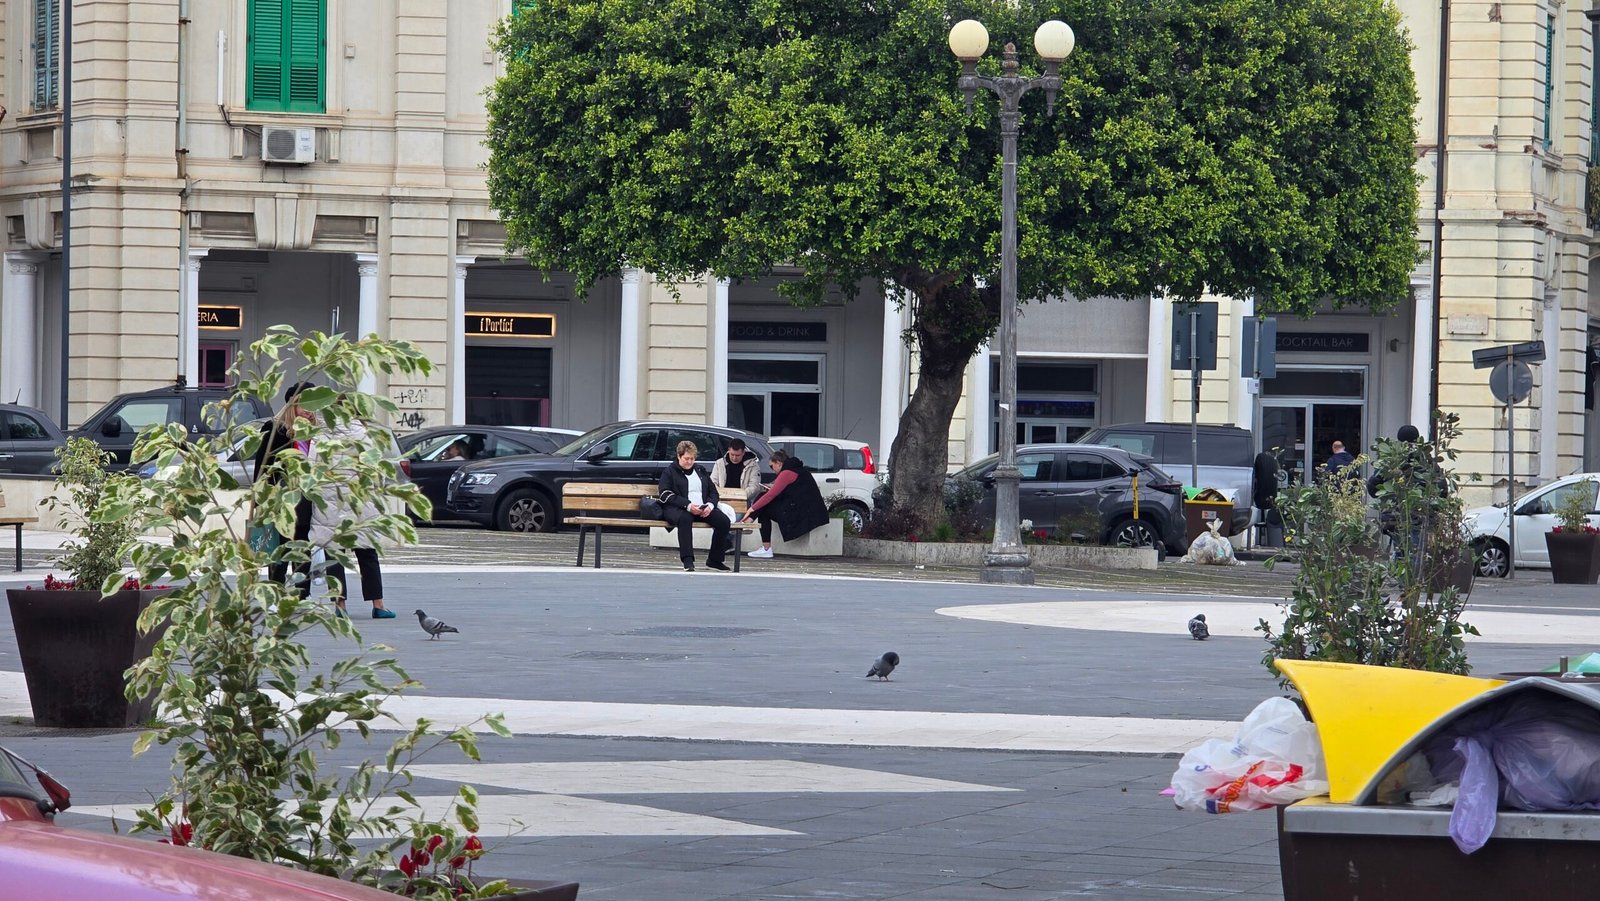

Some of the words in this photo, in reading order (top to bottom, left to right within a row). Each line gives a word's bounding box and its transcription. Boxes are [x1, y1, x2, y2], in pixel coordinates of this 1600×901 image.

[731, 326, 763, 336] FOOD
[767, 327, 775, 336] &
[778, 327, 810, 337] DRINK
[1331, 337, 1353, 348] BAR
